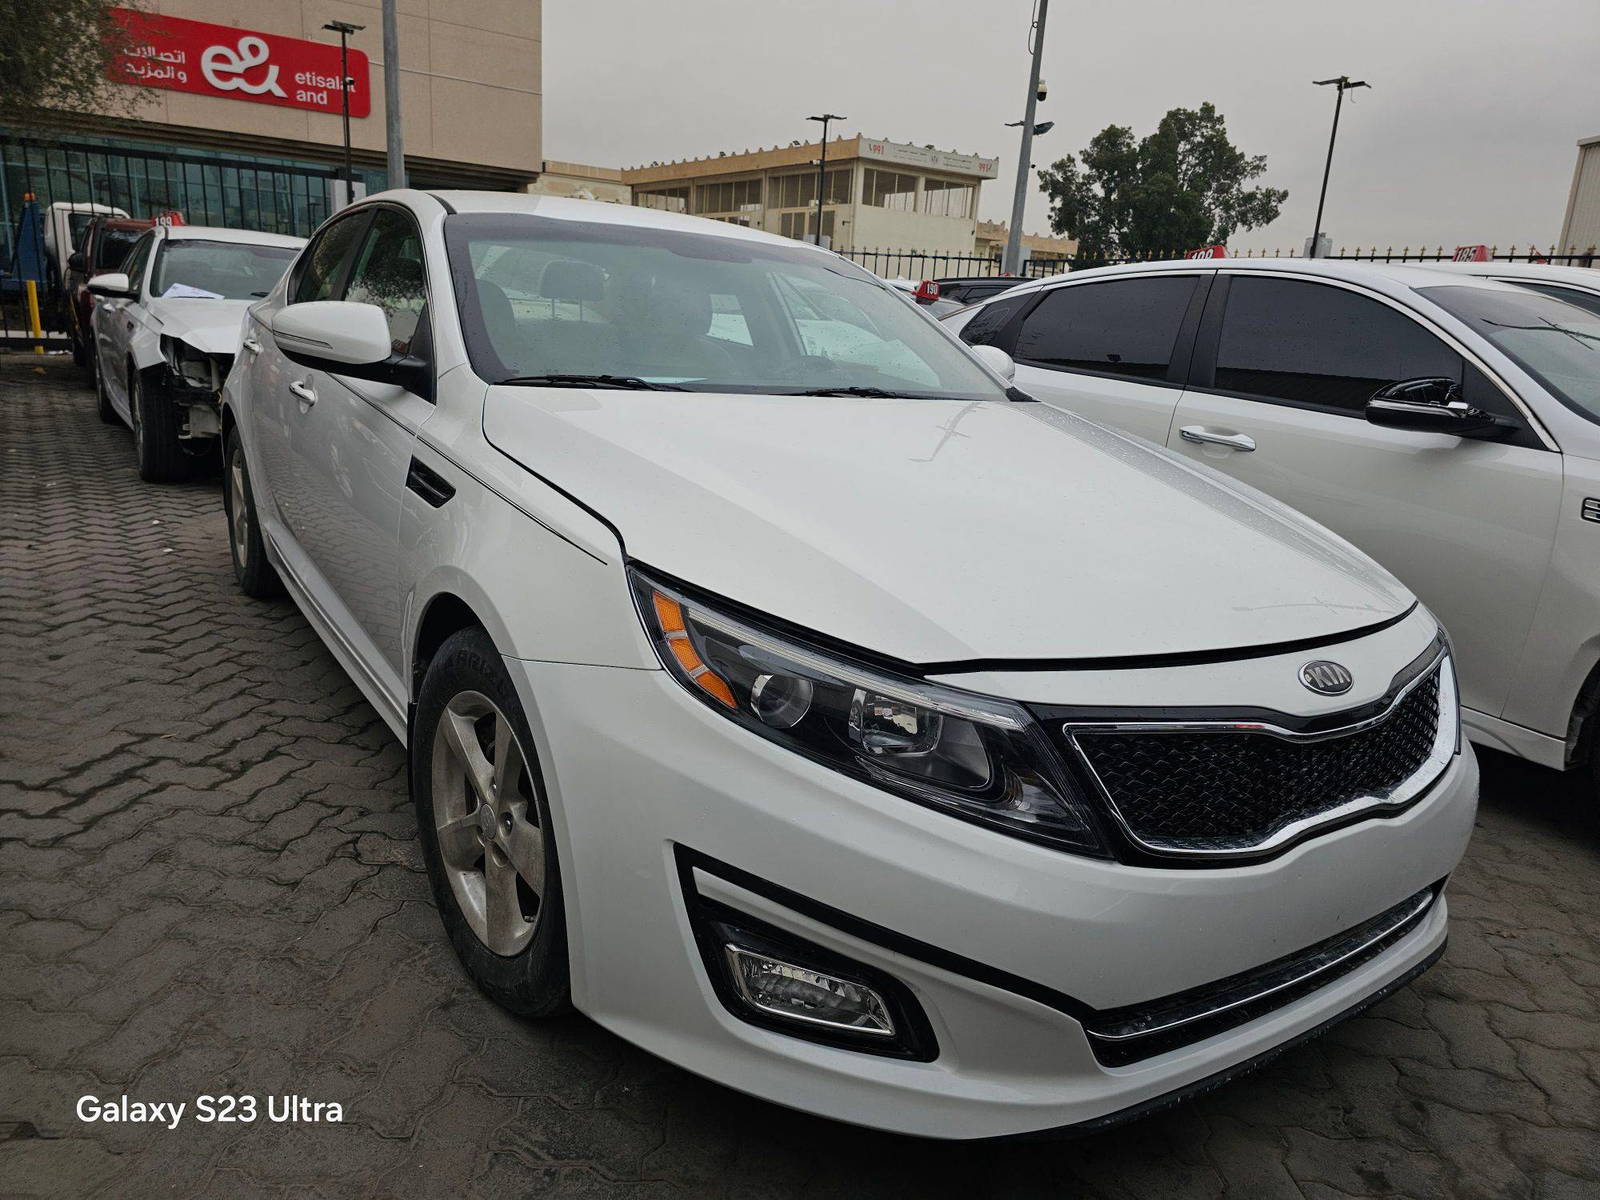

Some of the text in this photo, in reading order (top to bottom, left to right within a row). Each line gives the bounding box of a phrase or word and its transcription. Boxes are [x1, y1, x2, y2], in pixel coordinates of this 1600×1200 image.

[201, 36, 288, 98] e&
[296, 90, 328, 104] and
[155, 216, 172, 227] 199
[1455, 247, 1477, 262] 185
[1305, 664, 1351, 688] KIA
